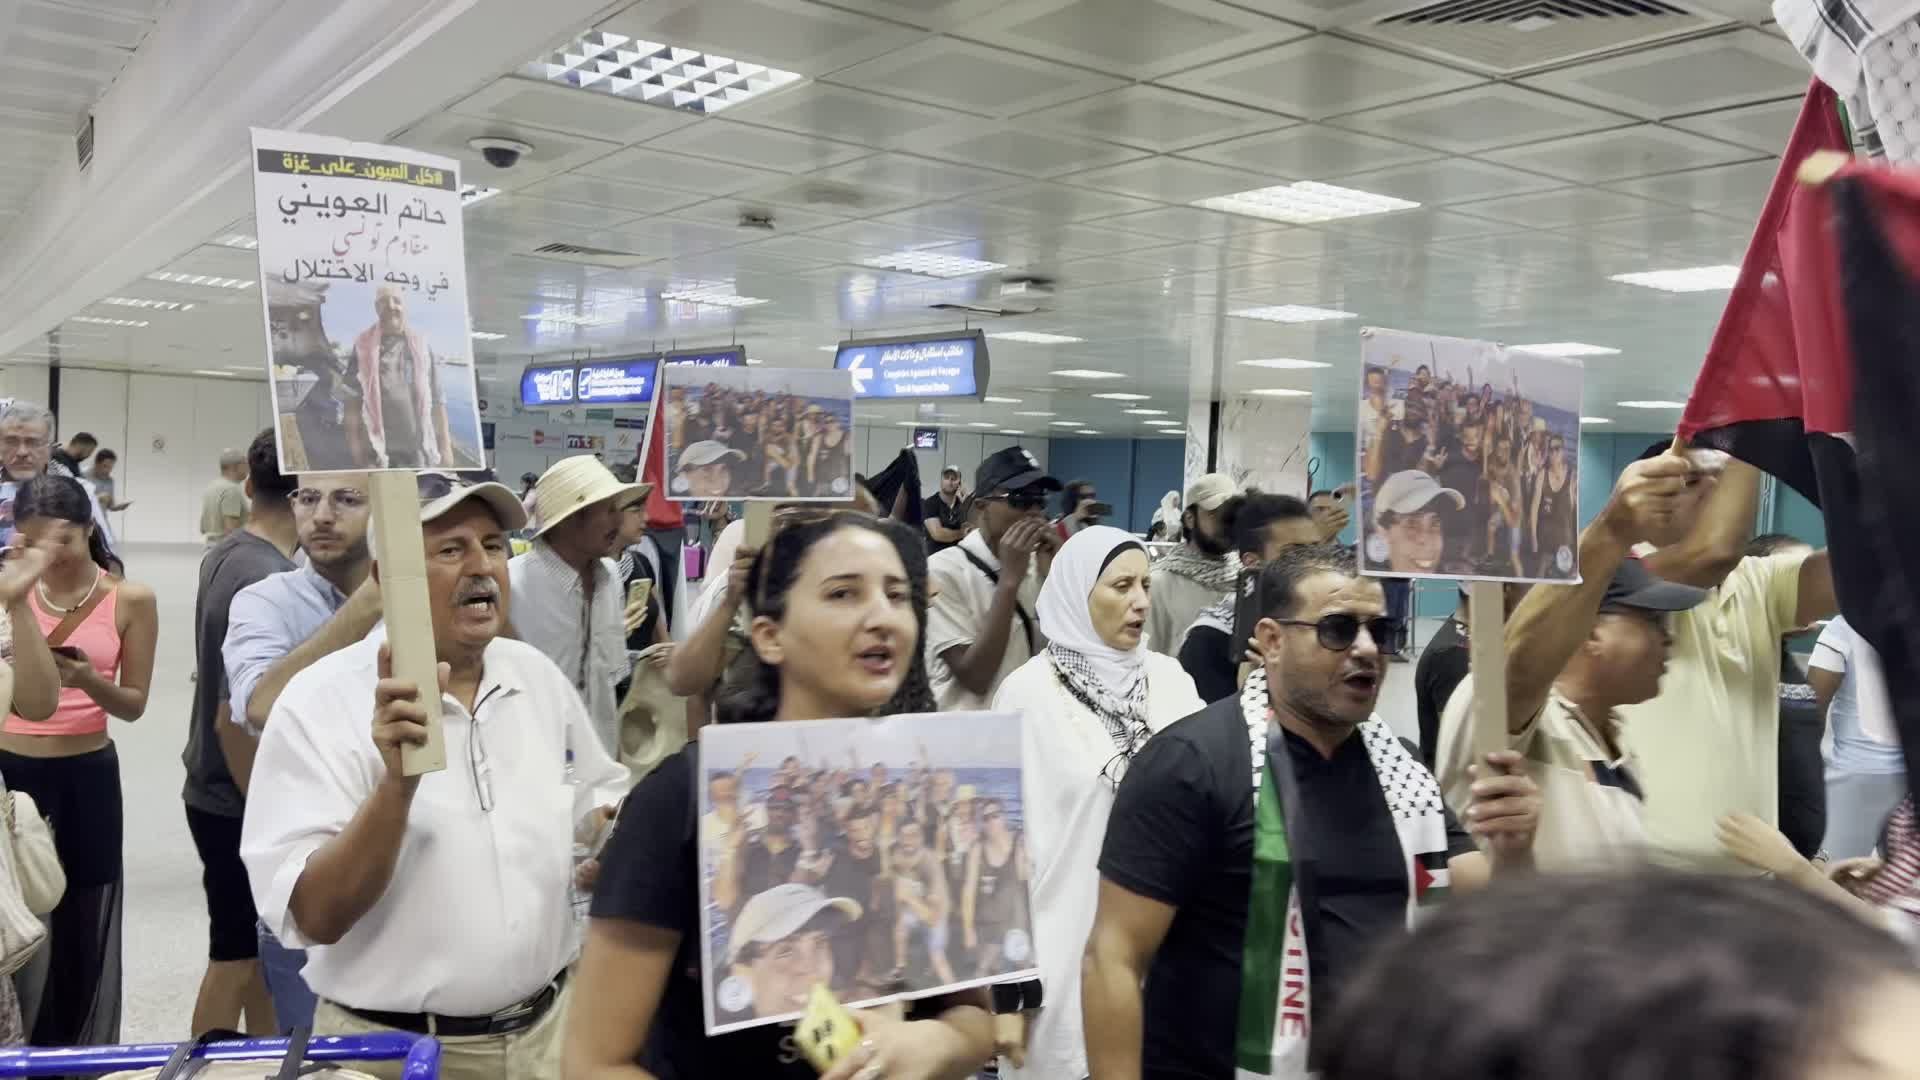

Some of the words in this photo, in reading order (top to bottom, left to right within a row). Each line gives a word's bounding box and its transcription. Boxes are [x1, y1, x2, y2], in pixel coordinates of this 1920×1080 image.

[278, 182, 388, 225] العويني
[398, 197, 447, 229] حاتم
[283, 258, 375, 284] الاحتلال
[383, 270, 421, 291] وجه
[426, 271, 449, 301] في
